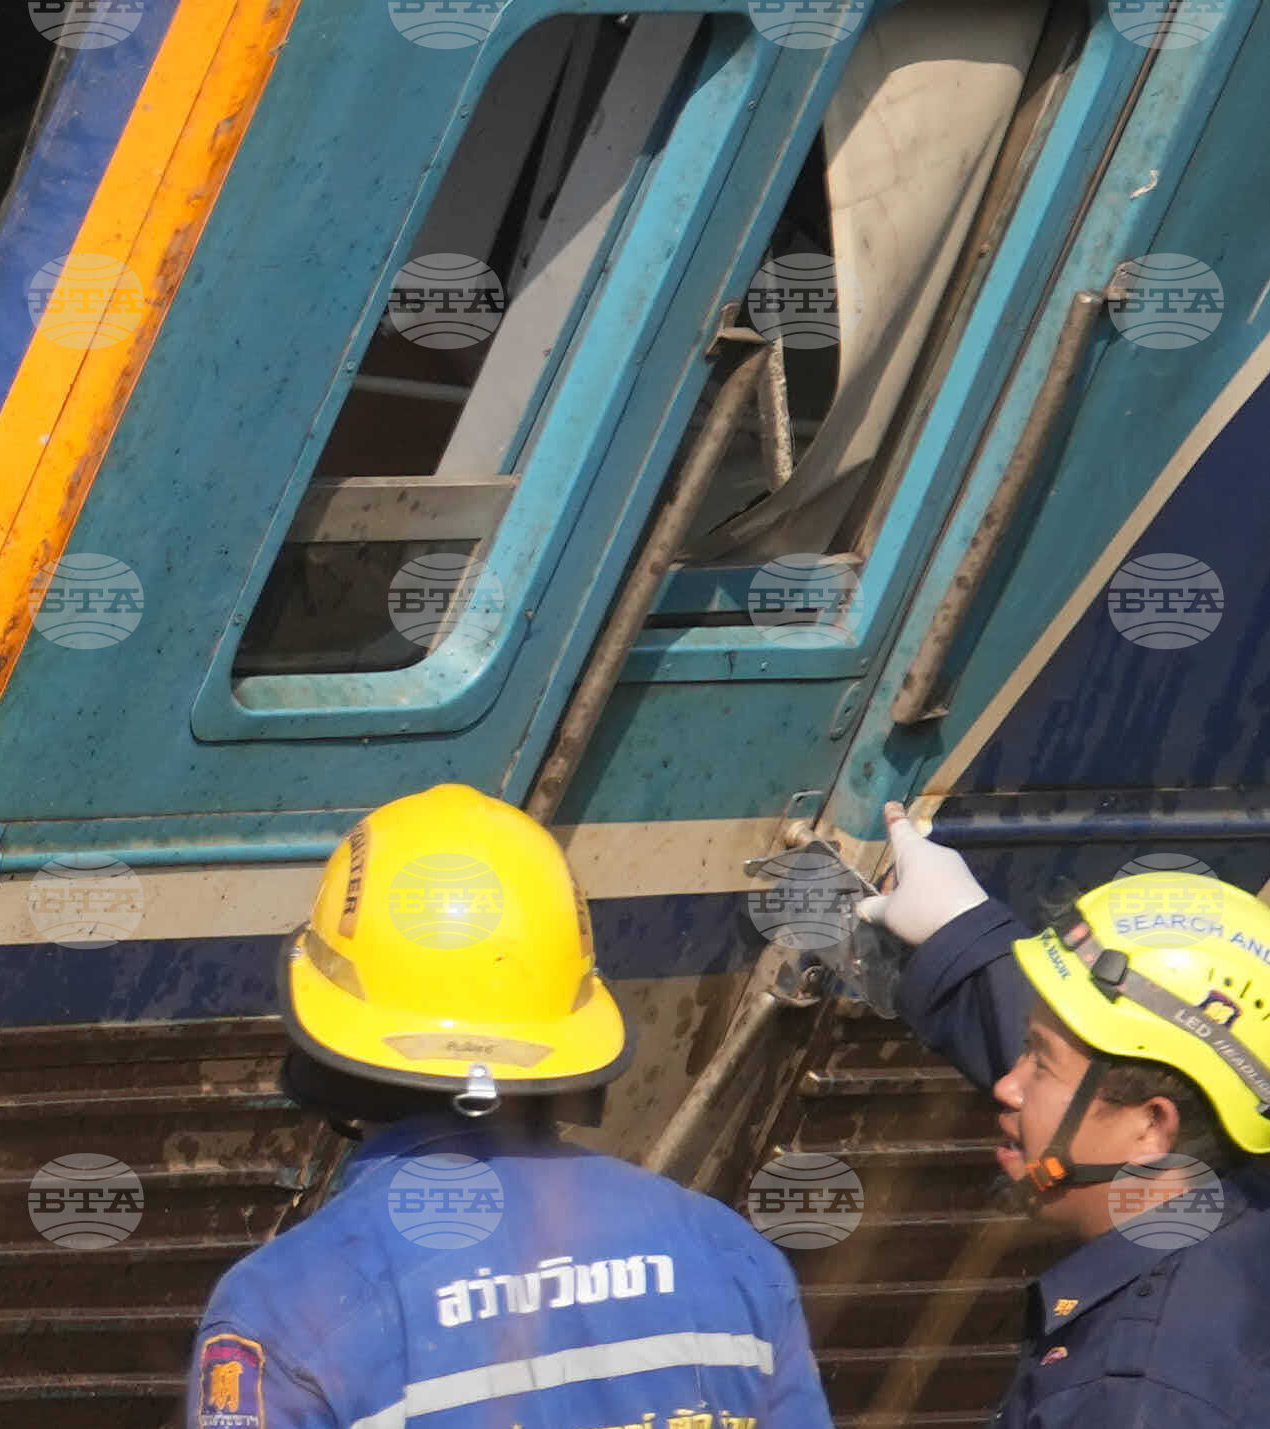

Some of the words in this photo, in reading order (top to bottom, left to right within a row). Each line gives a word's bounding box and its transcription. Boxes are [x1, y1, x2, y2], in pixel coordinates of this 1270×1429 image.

[1115, 914, 1224, 937] SEARCH
[1175, 1009, 1212, 1038] LED
[436, 1253, 675, 1328] สว่างวิชชา
